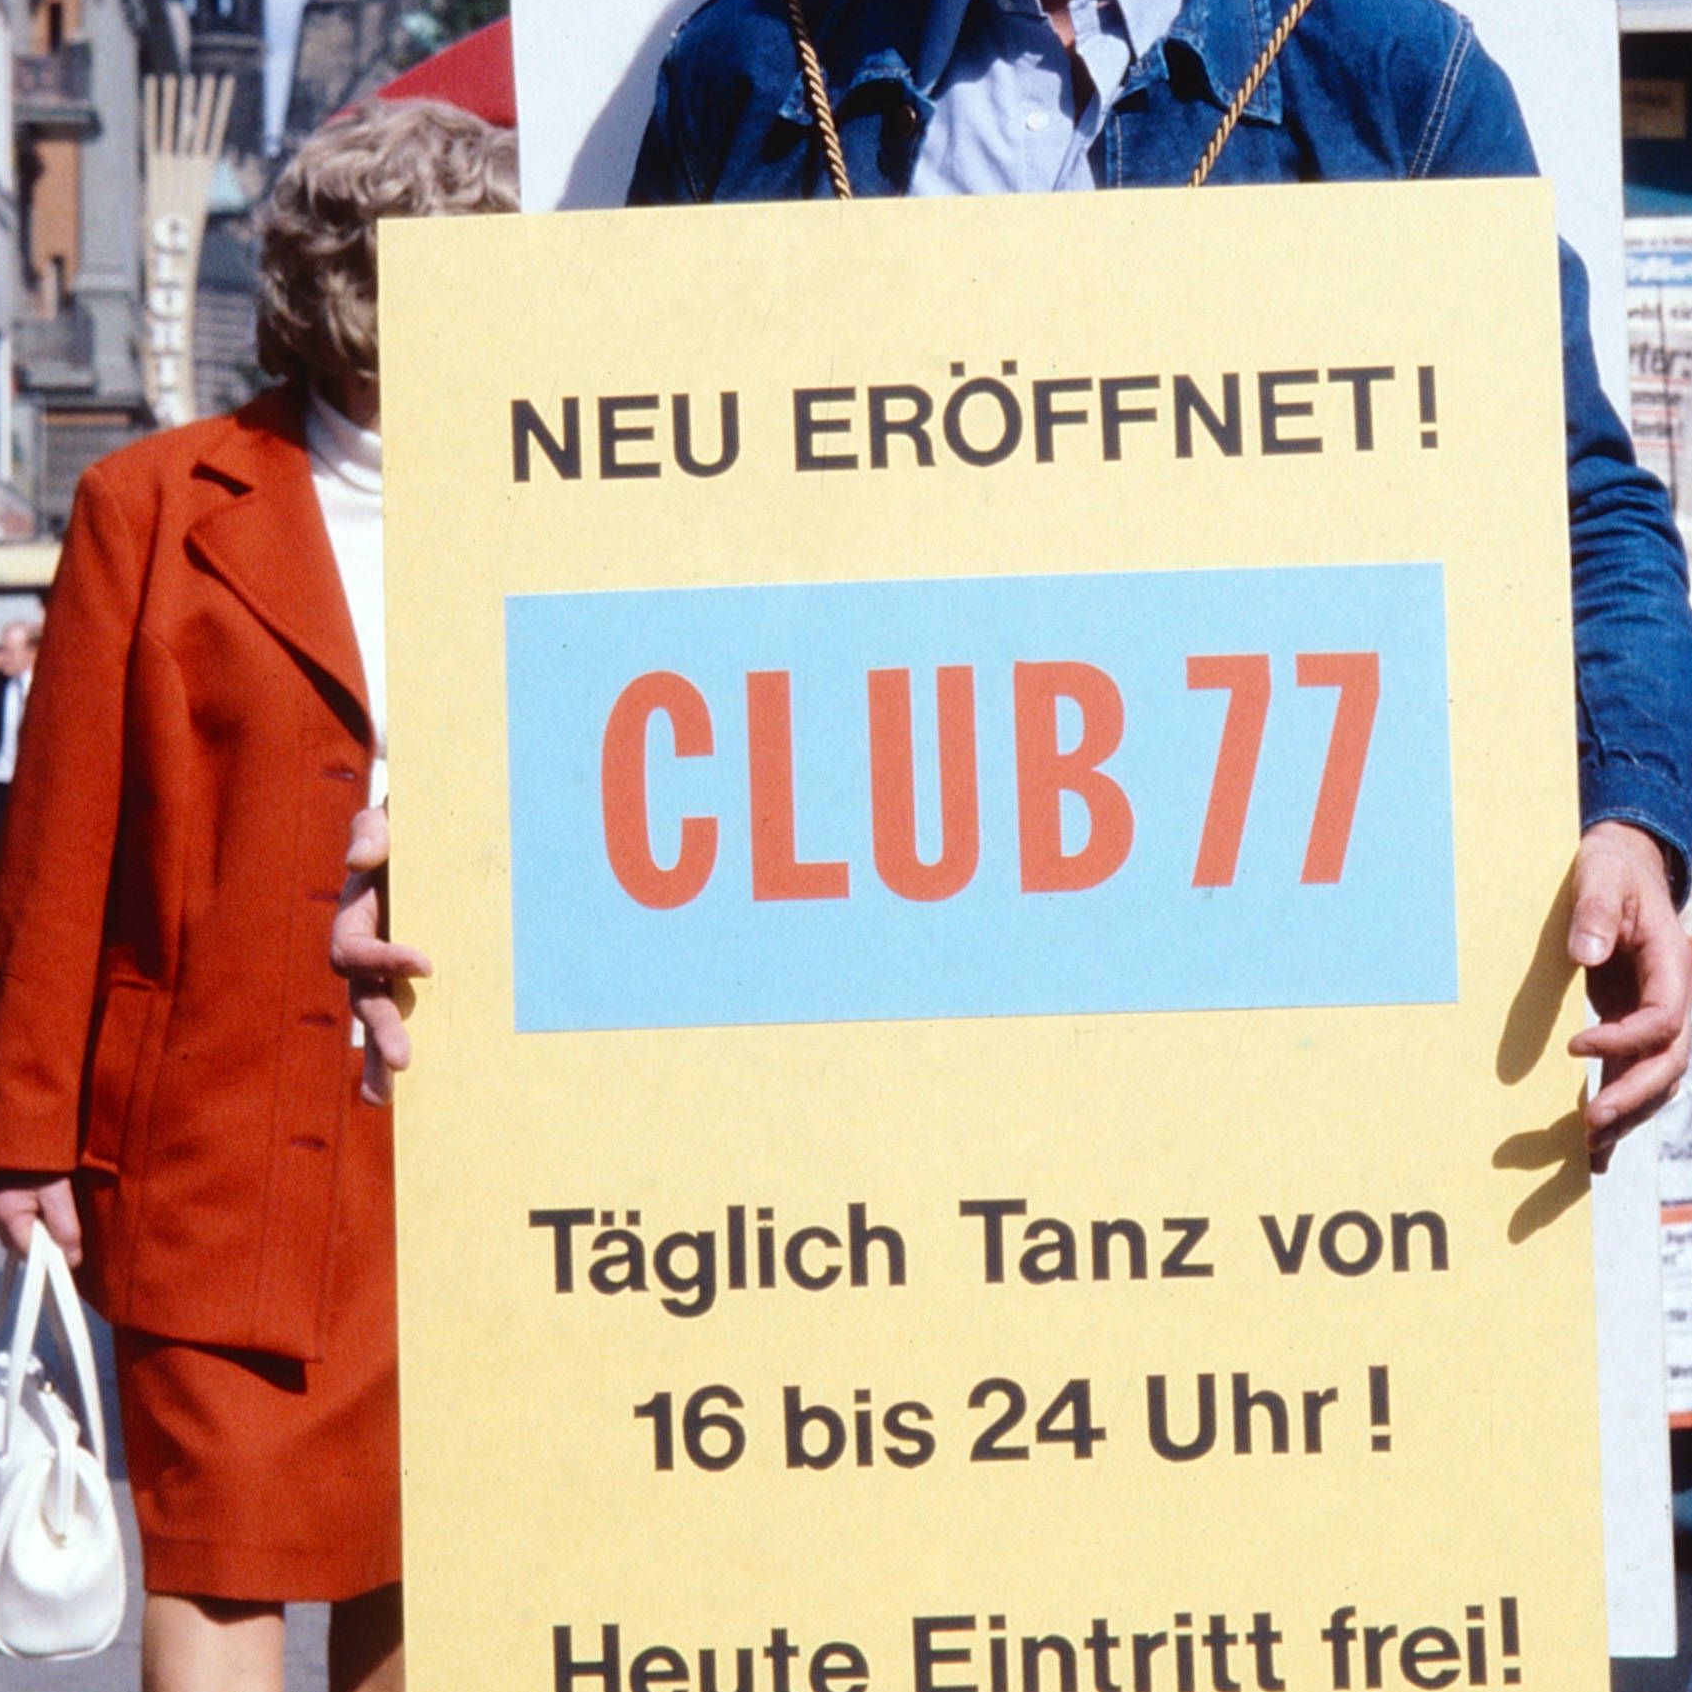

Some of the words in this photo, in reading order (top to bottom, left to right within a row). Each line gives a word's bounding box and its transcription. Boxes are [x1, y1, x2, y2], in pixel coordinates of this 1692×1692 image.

[512, 393, 738, 481] NEU
[794, 359, 1439, 471] ERÖFFNET!
[601, 660, 1135, 910] CLUB
[1186, 652, 1380, 887] 77
[530, 1203, 907, 1317] Täglich
[960, 1199, 1214, 1284] Tanz
[1260, 1208, 1449, 1276] von
[634, 1385, 746, 1471] 16
[784, 1386, 936, 1469] bis
[969, 1378, 1106, 1461] 24
[1321, 1597, 1522, 1689] frei!
